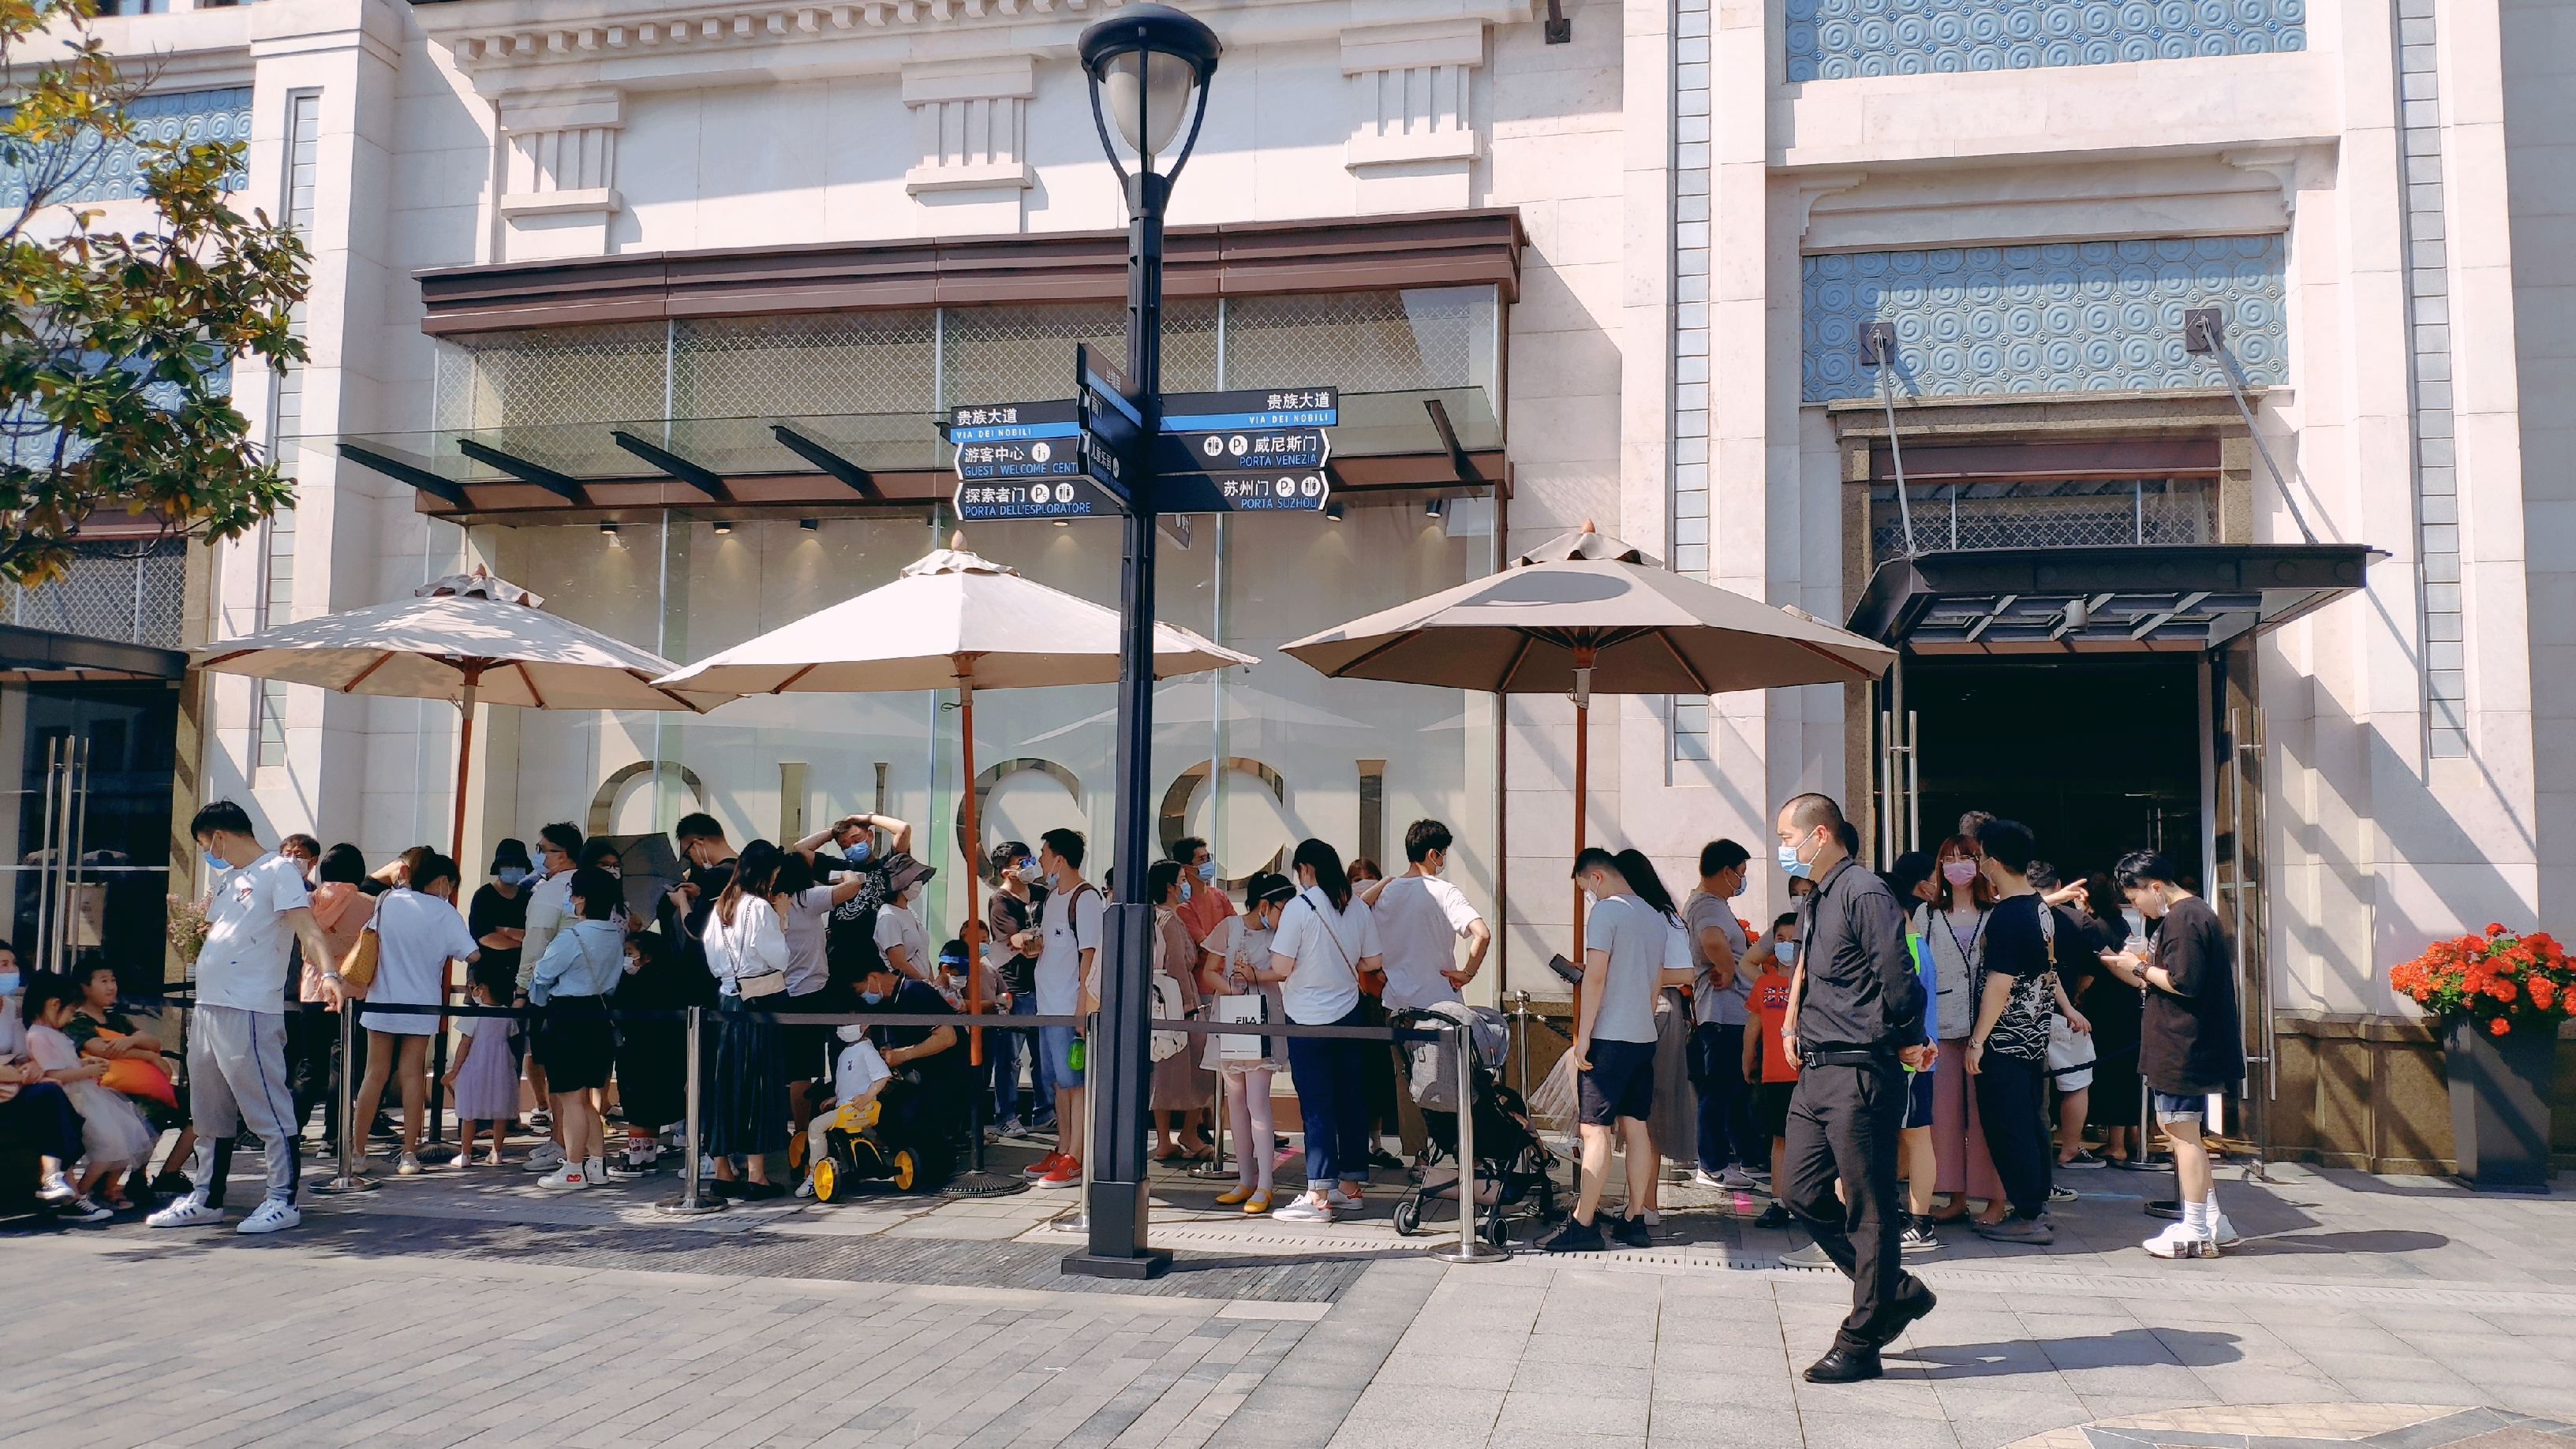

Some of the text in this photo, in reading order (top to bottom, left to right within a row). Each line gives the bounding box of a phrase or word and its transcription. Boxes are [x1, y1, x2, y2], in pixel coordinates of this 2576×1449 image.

[1267, 392, 1329, 410] 贵族大道
[957, 408, 1018, 426] 贵族大道
[1249, 413, 1328, 424] VIA DEI NOBILI
[957, 428, 1031, 439] VIA DEI NOBILI
[1254, 435, 1317, 453] 威尼斯门
[965, 446, 1025, 463] 游客中心
[1239, 454, 1317, 467] PORTA VENEZIA
[965, 462, 1079, 476] GUEST WELCOME CENT
[965, 487, 1025, 503] 探索者门
[1224, 480, 1269, 497] 苏州门
[965, 502, 1091, 517] PORTA DELL'ESPLORATORE
[1241, 497, 1318, 509] PORTA SUZHOU
[1236, 1016, 1257, 1025] FILA
